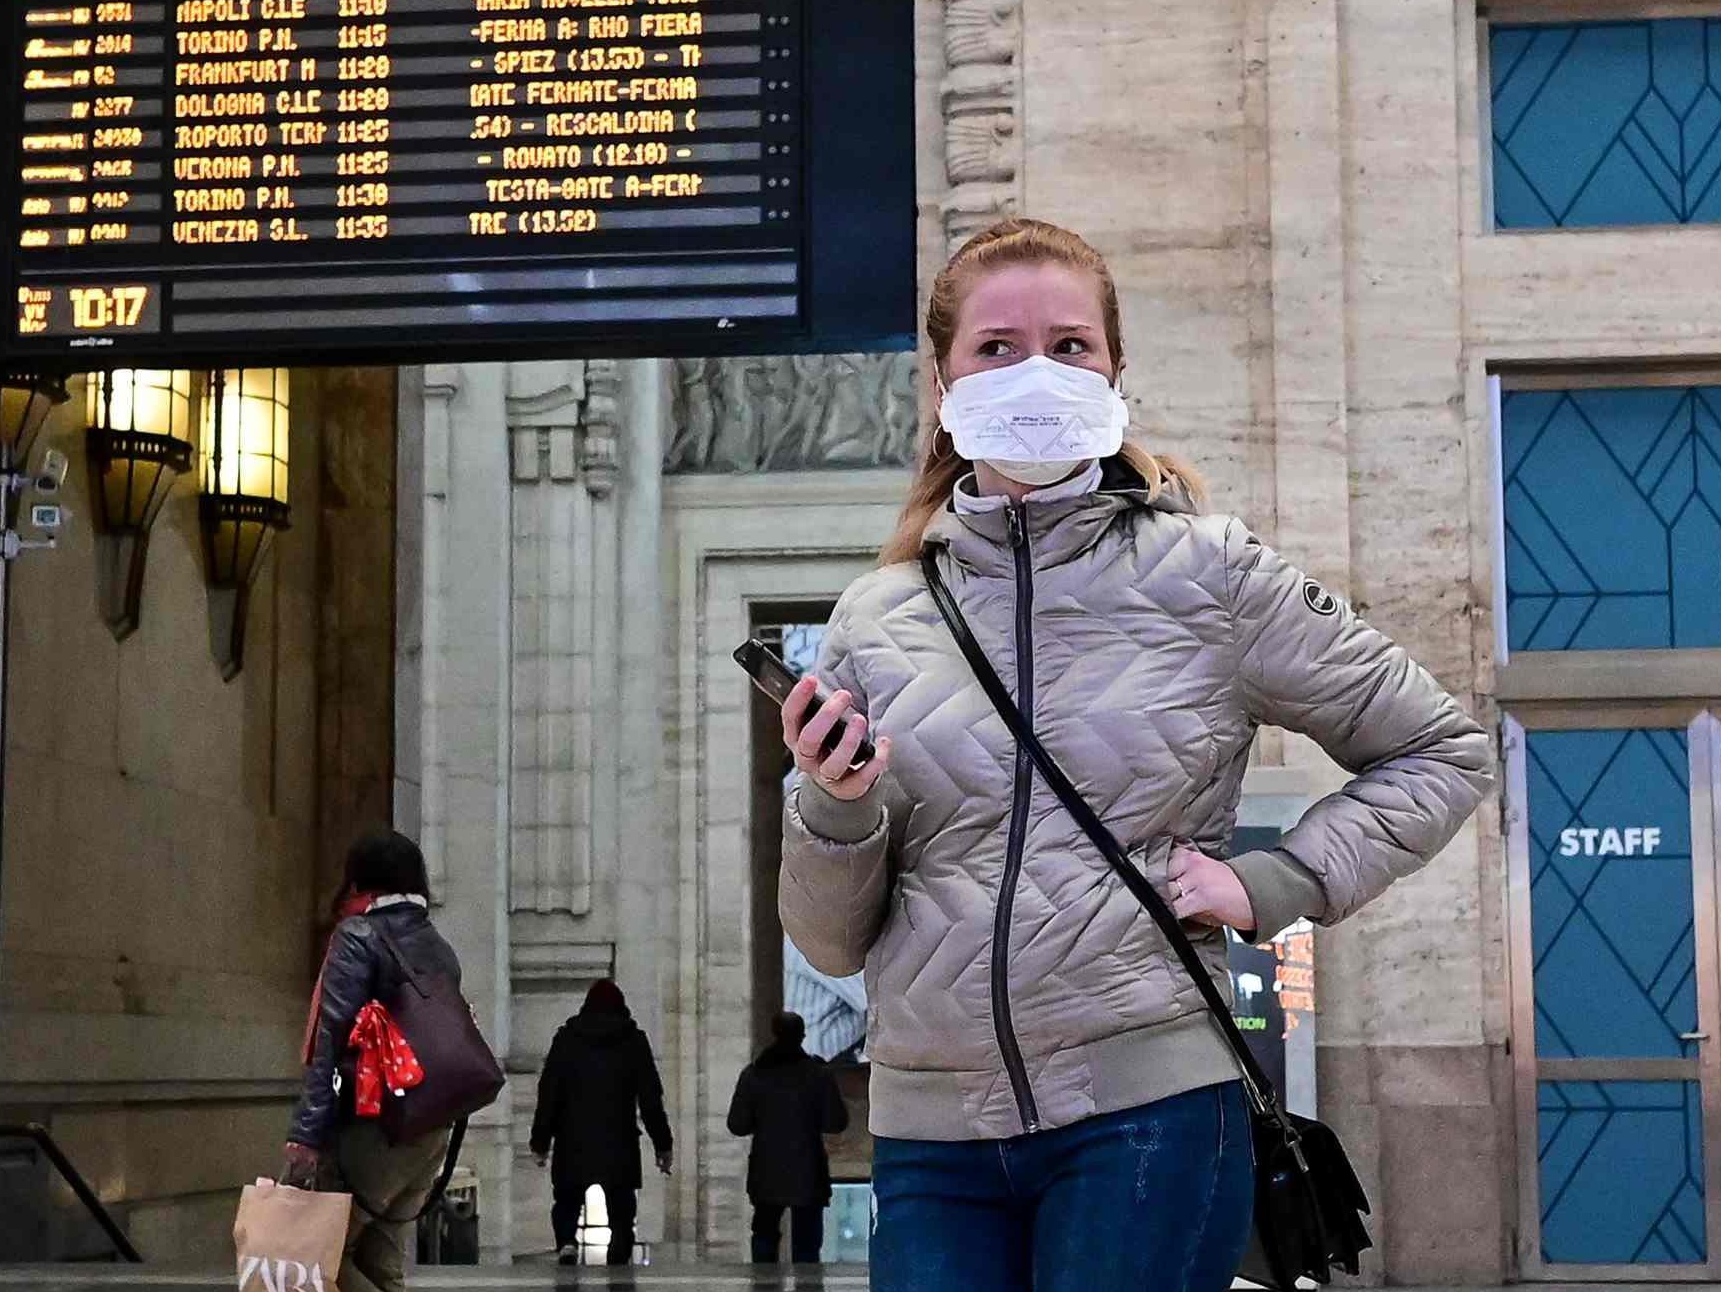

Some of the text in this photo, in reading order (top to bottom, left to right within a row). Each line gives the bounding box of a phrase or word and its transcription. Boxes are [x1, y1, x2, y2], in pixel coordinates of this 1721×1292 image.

[300, 58, 316, 81] M
[174, 123, 268, 149] ROPORTO
[69, 287, 147, 327] 10:17
[1558, 826, 1662, 857] STAFF
